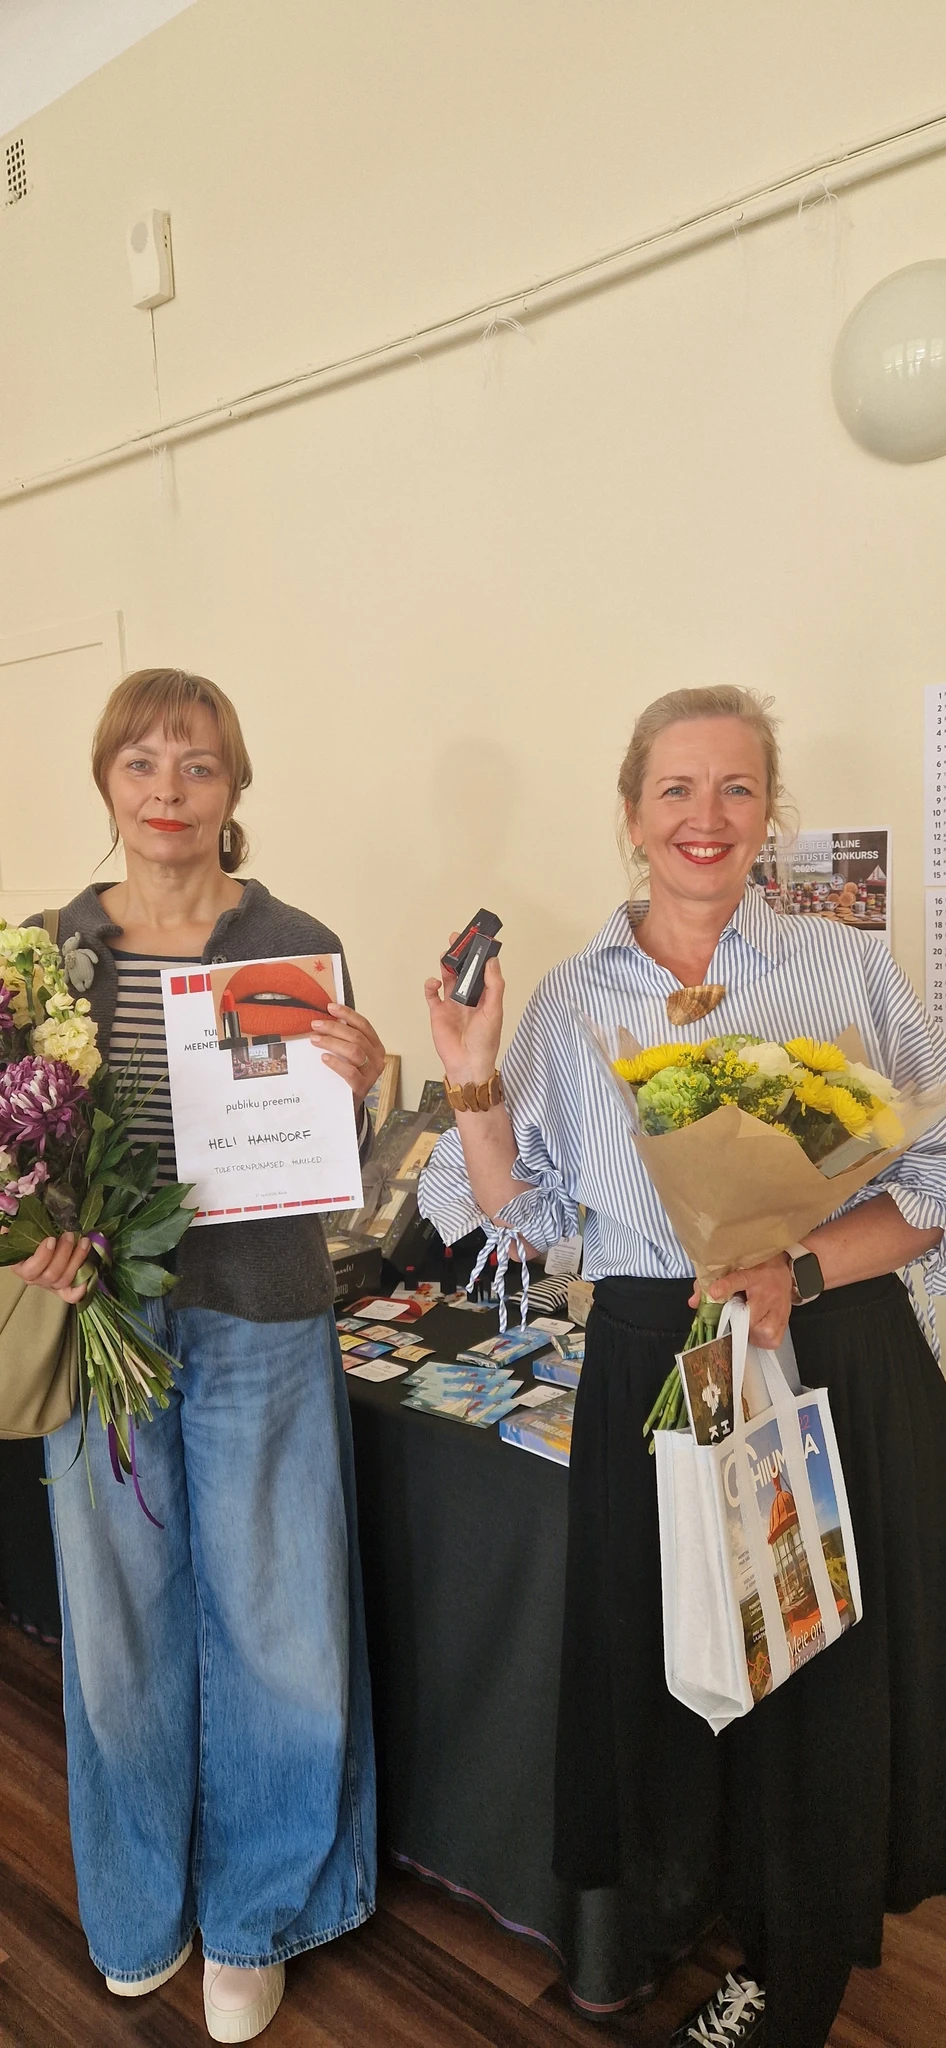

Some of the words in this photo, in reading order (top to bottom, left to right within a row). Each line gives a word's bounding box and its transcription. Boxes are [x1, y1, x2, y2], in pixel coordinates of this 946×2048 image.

[937, 704, 942, 712] 2
[937, 717, 942, 725] 3
[936, 760, 942, 768] 6
[934, 821, 941, 829] 11
[933, 833, 942, 841] 12
[811, 839, 861, 850] TEEMALINE
[933, 847, 942, 855] 13
[766, 854, 777, 863] JA
[831, 850, 879, 860] KONKURSS
[932, 859, 942, 867] 14
[794, 864, 816, 873] 2026
[933, 871, 942, 879] 15
[934, 897, 943, 905] 16
[935, 909, 943, 917] 17
[934, 921, 943, 929] 18
[934, 962, 943, 970] 21
[933, 992, 943, 1000] 23
[203, 1028, 218, 1037] TUL
[184, 1040, 219, 1052] MEENET
[226, 1099, 260, 1114] publiku
[262, 1094, 301, 1110] preemia
[208, 1136, 237, 1150] HELI
[247, 1129, 312, 1146] HAHNDORF
